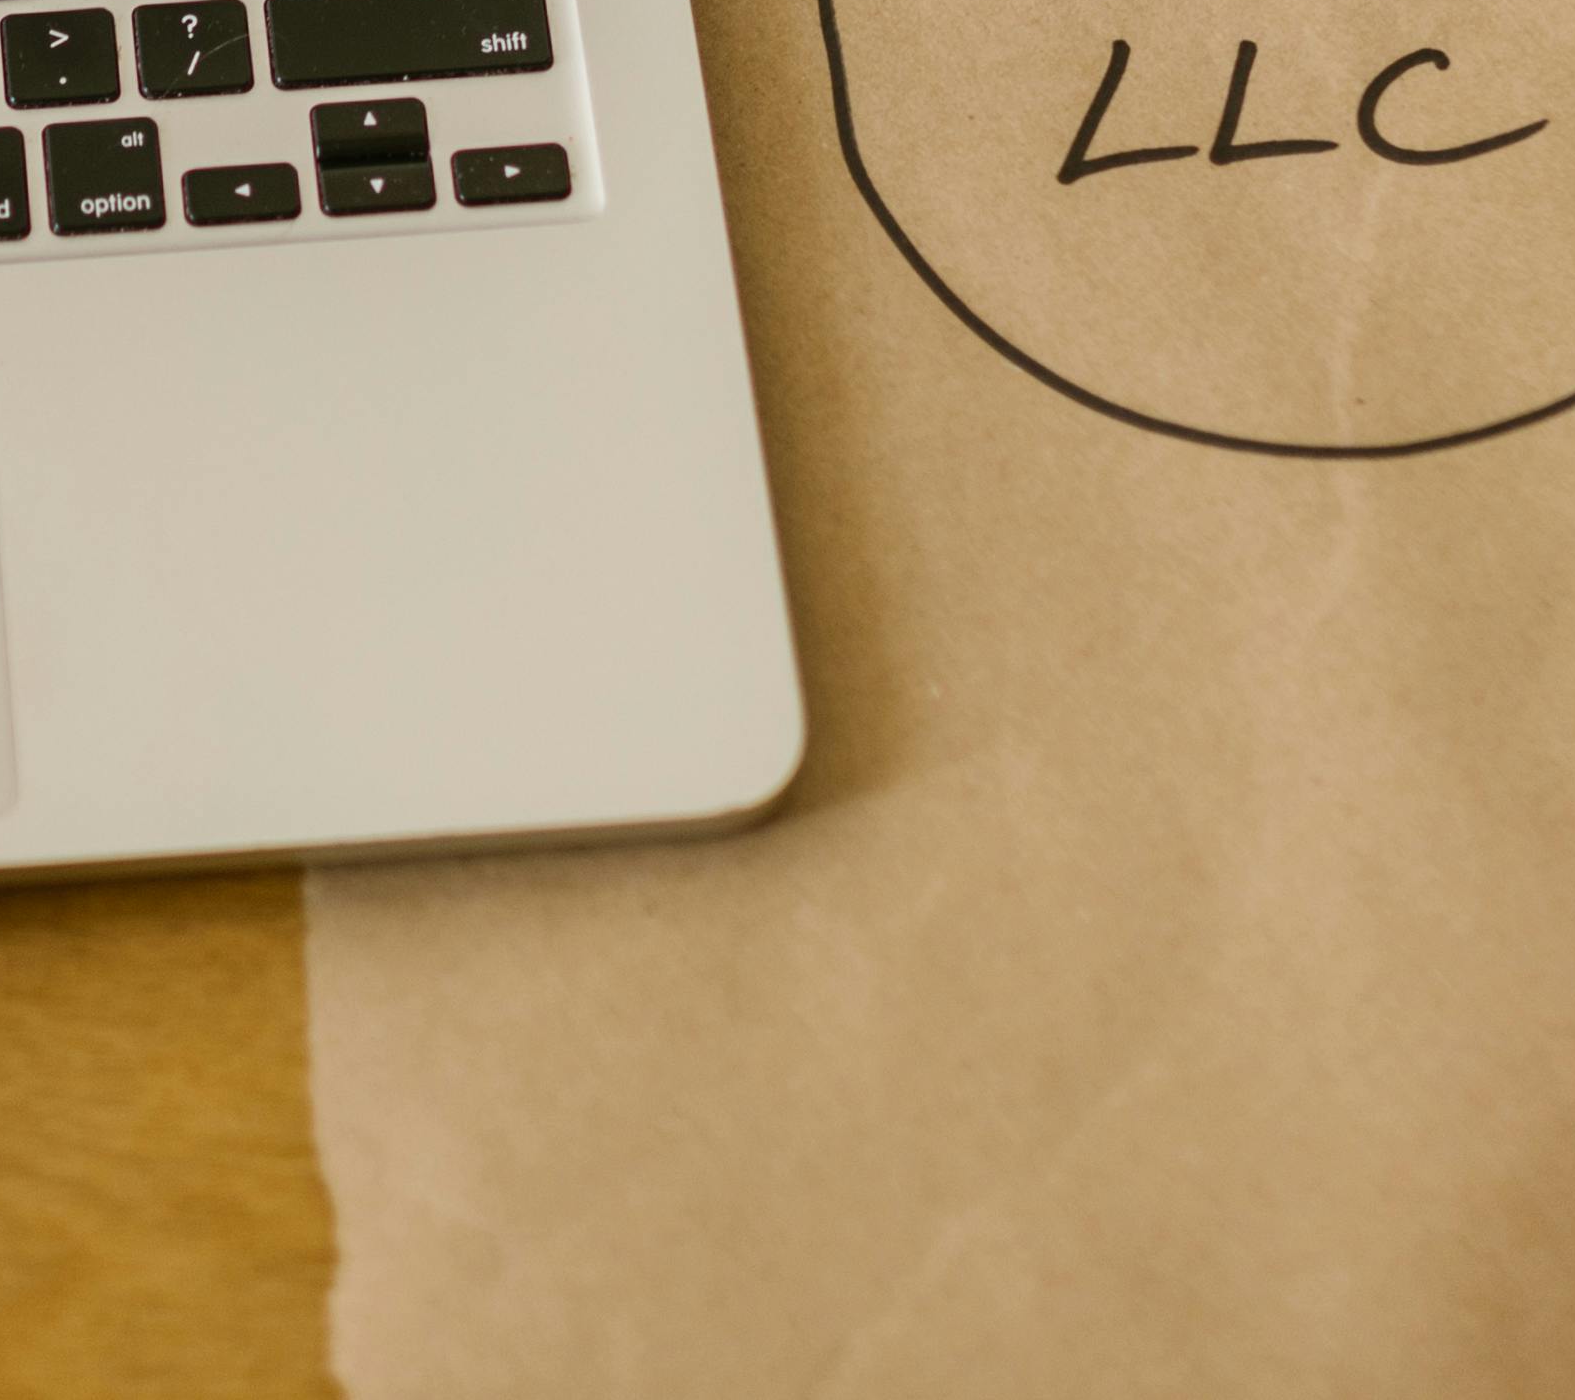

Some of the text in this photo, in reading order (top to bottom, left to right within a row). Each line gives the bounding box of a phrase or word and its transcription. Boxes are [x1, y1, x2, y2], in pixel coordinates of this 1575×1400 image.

[480, 31, 527, 54] shift
[1057, 39, 1550, 185] LLC
[120, 130, 144, 148] alt
[80, 192, 151, 218] option
